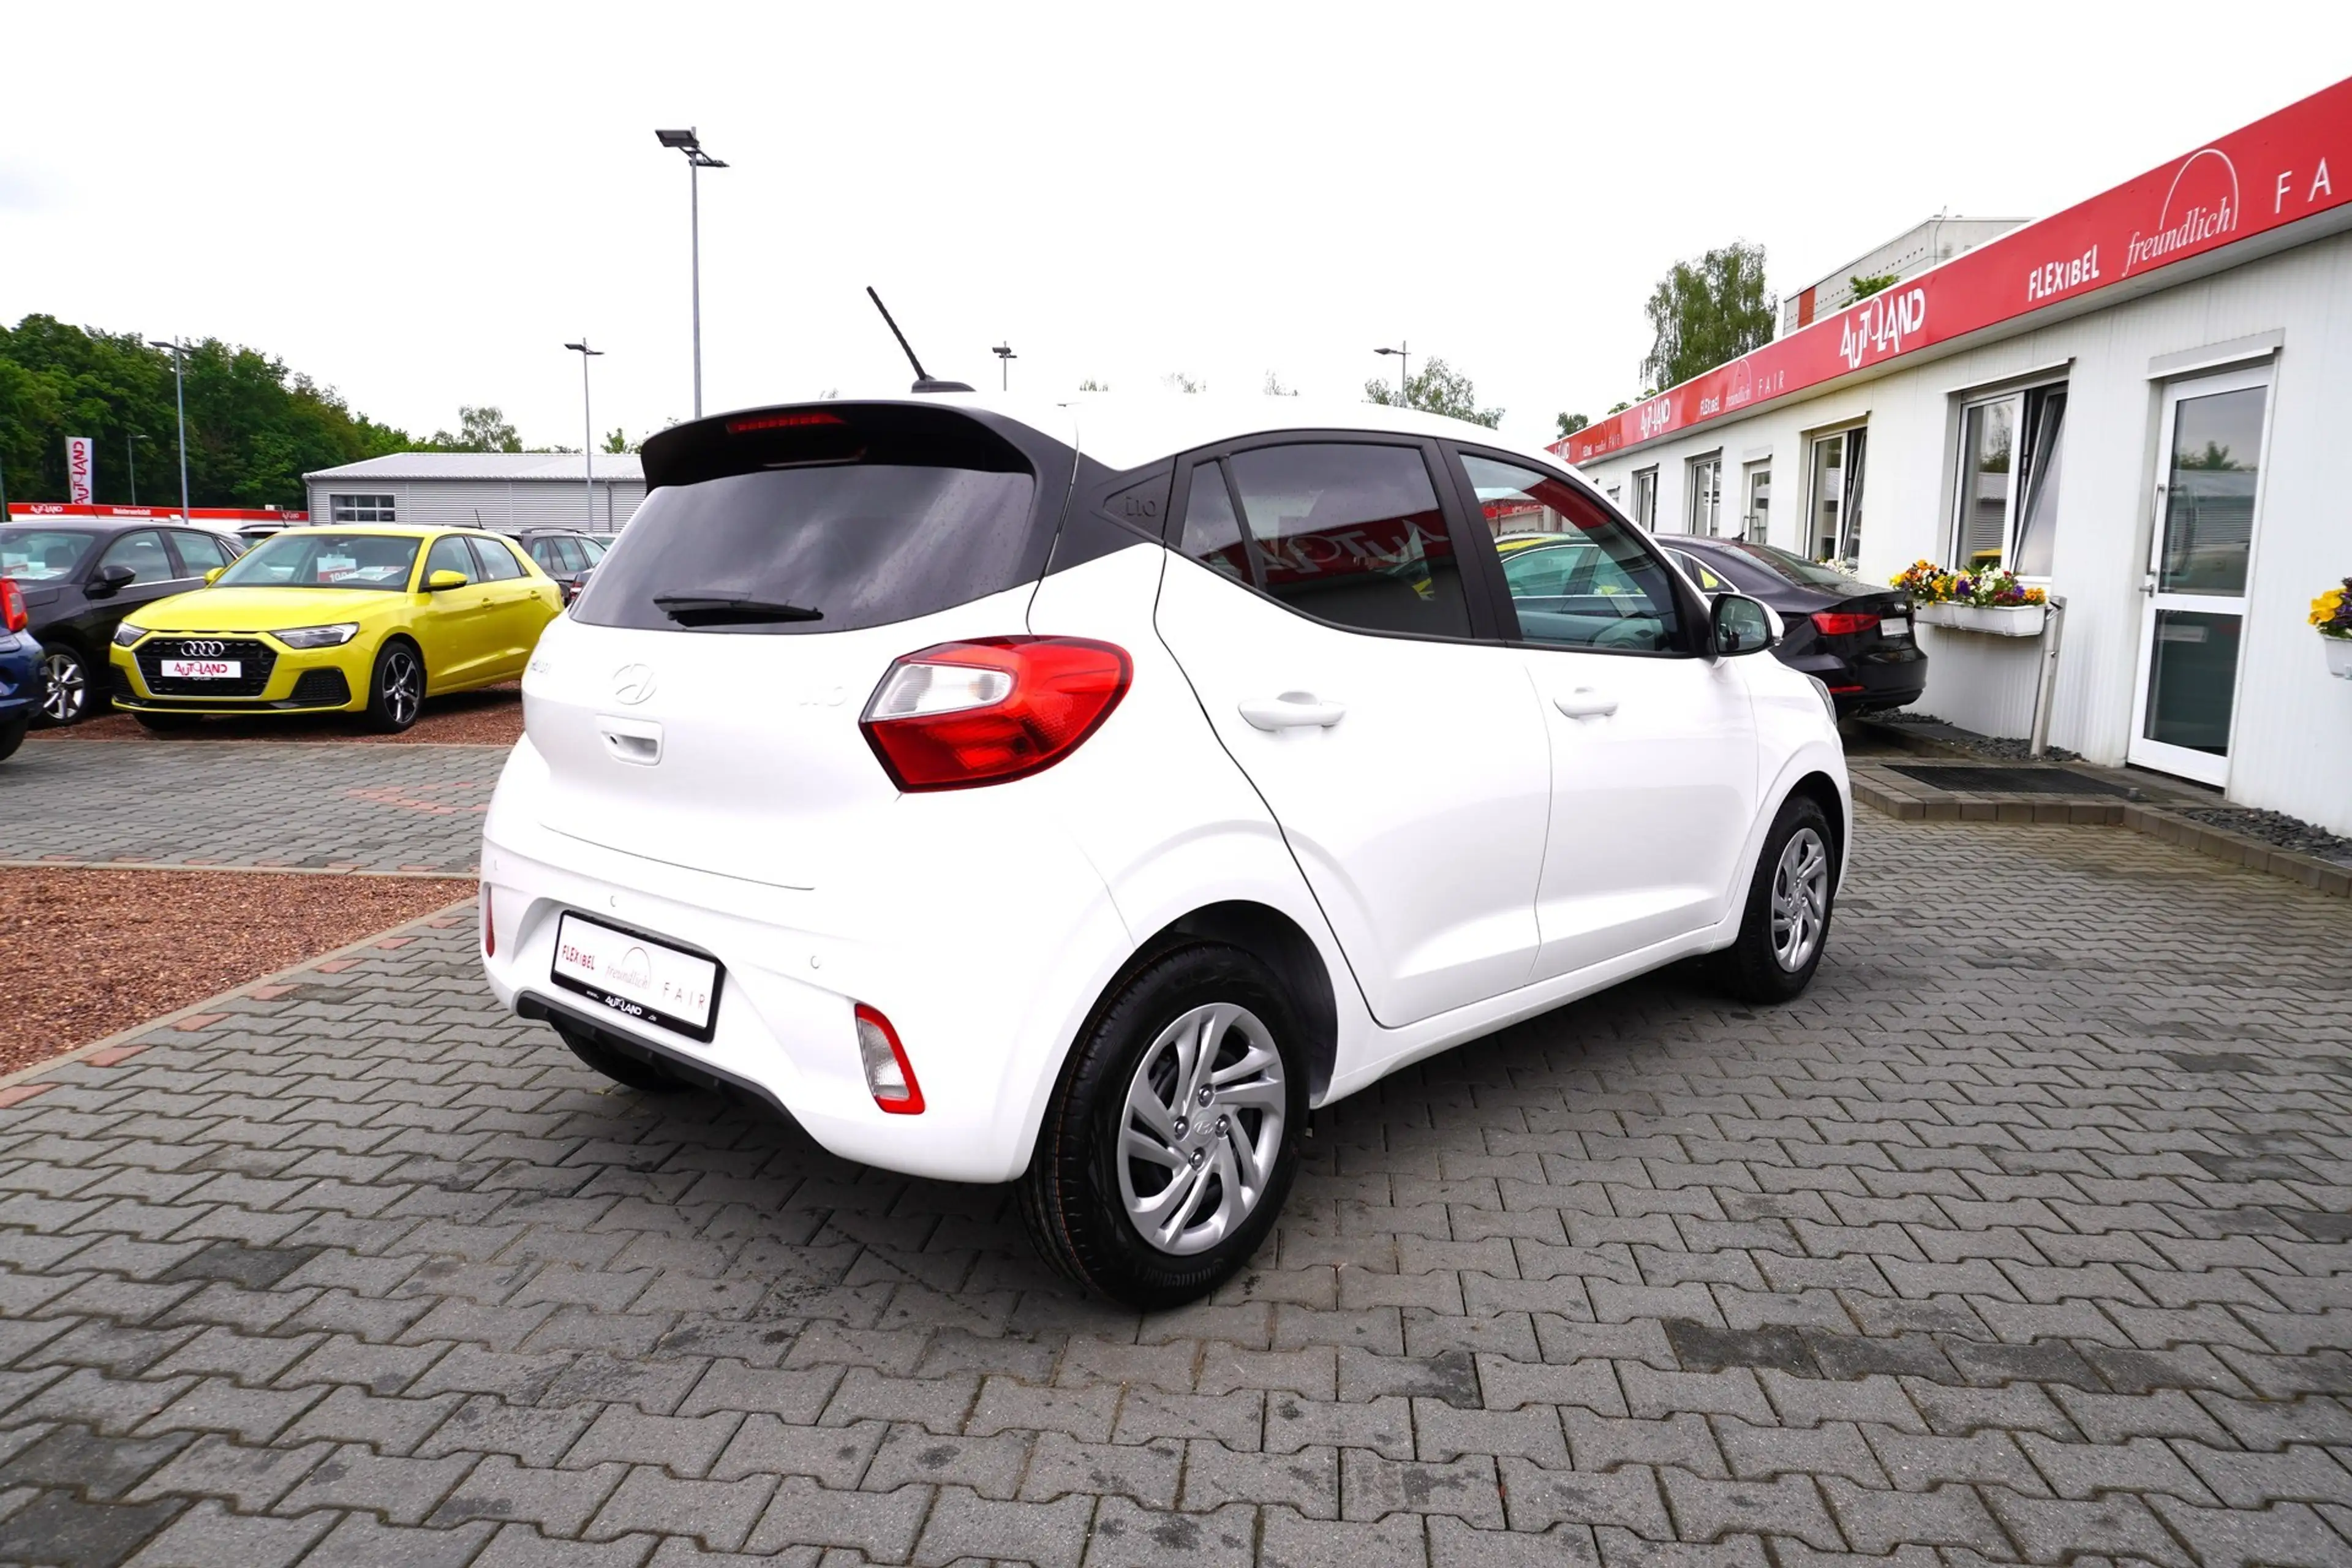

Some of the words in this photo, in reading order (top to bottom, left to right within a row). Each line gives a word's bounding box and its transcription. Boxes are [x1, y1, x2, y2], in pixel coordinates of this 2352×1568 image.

[2028, 244, 2100, 302] FLEXIBEL
[2122, 197, 2231, 277] freundlich
[1839, 288, 1926, 369] AUTOLAND
[1758, 370, 1785, 397] FAIR
[1640, 399, 1671, 439] AUTOLAND
[174, 661, 228, 676] AUTOLAND
[562, 944, 595, 971] FLEXIBEL
[605, 963, 648, 990] freundlich
[662, 982, 705, 1011] FAIR
[605, 995, 643, 1016] AUTOLAND
